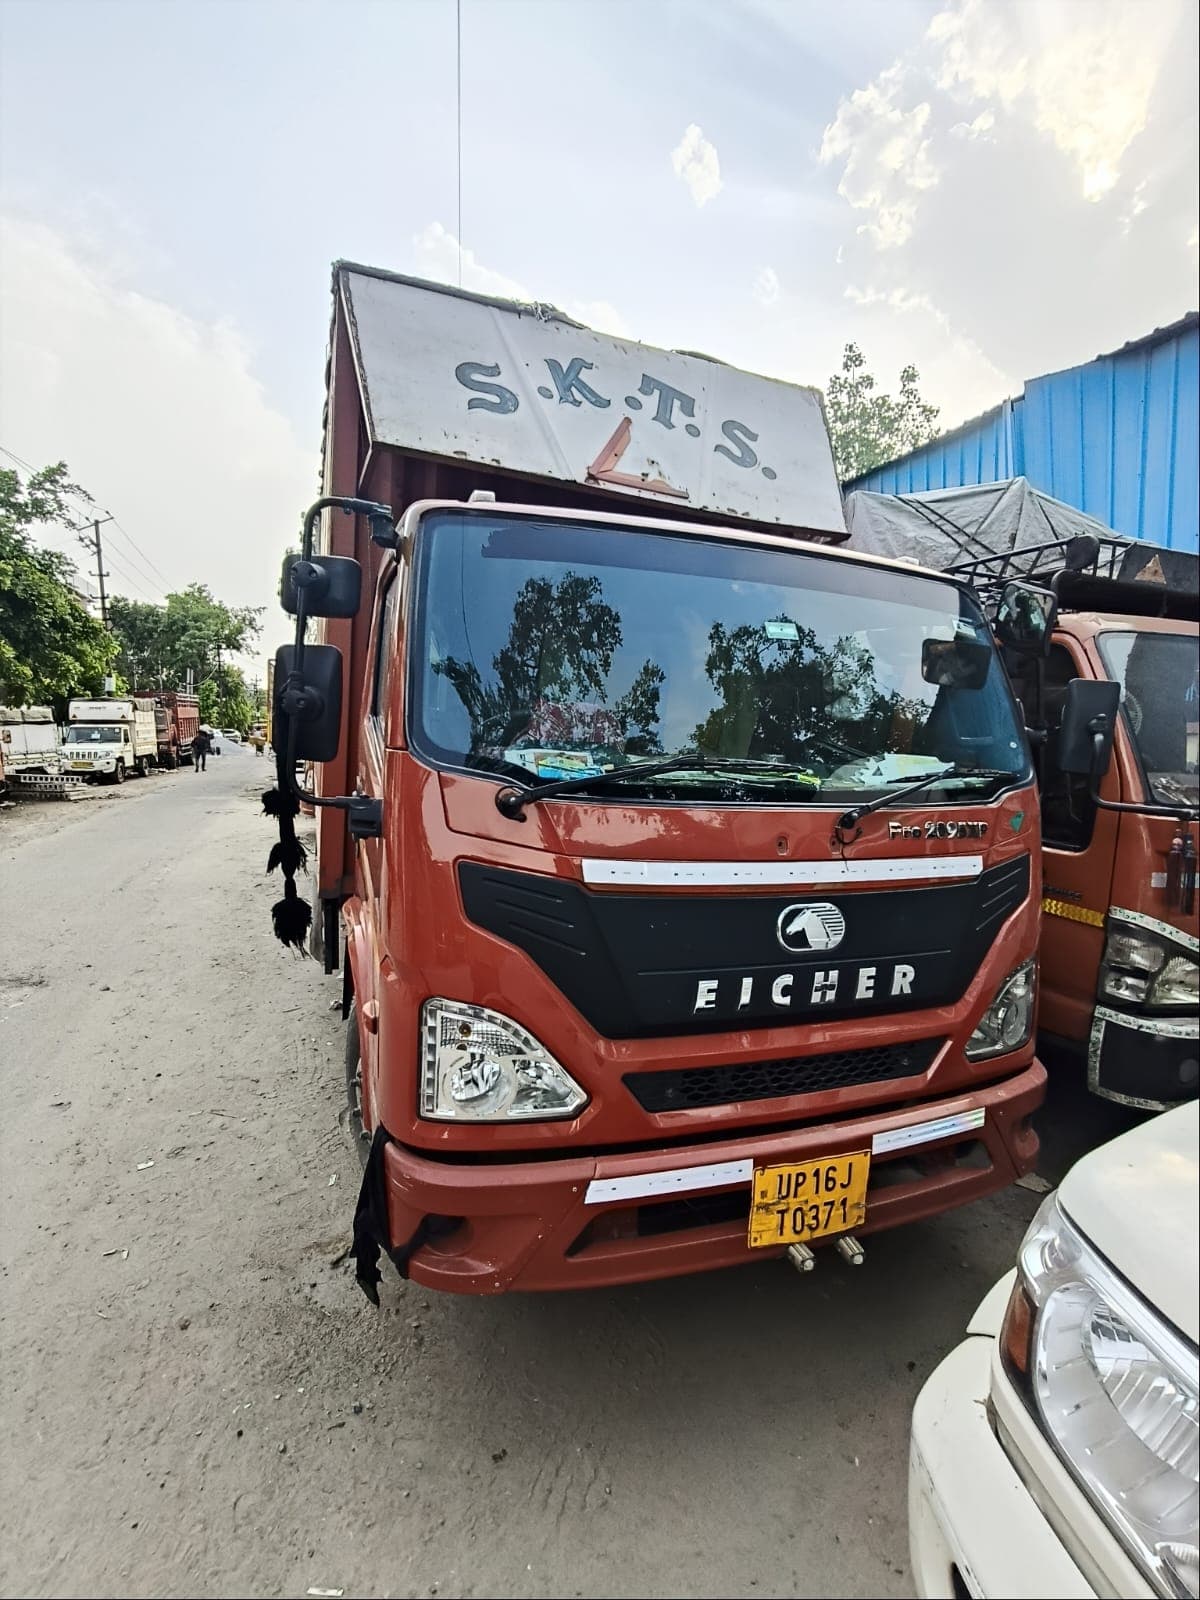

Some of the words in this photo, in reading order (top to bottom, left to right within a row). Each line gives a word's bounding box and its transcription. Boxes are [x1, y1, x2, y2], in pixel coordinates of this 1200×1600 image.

[889, 821, 922, 839] Pro
[693, 963, 916, 1014] EICHER
[776, 1197, 848, 1237] T0371
